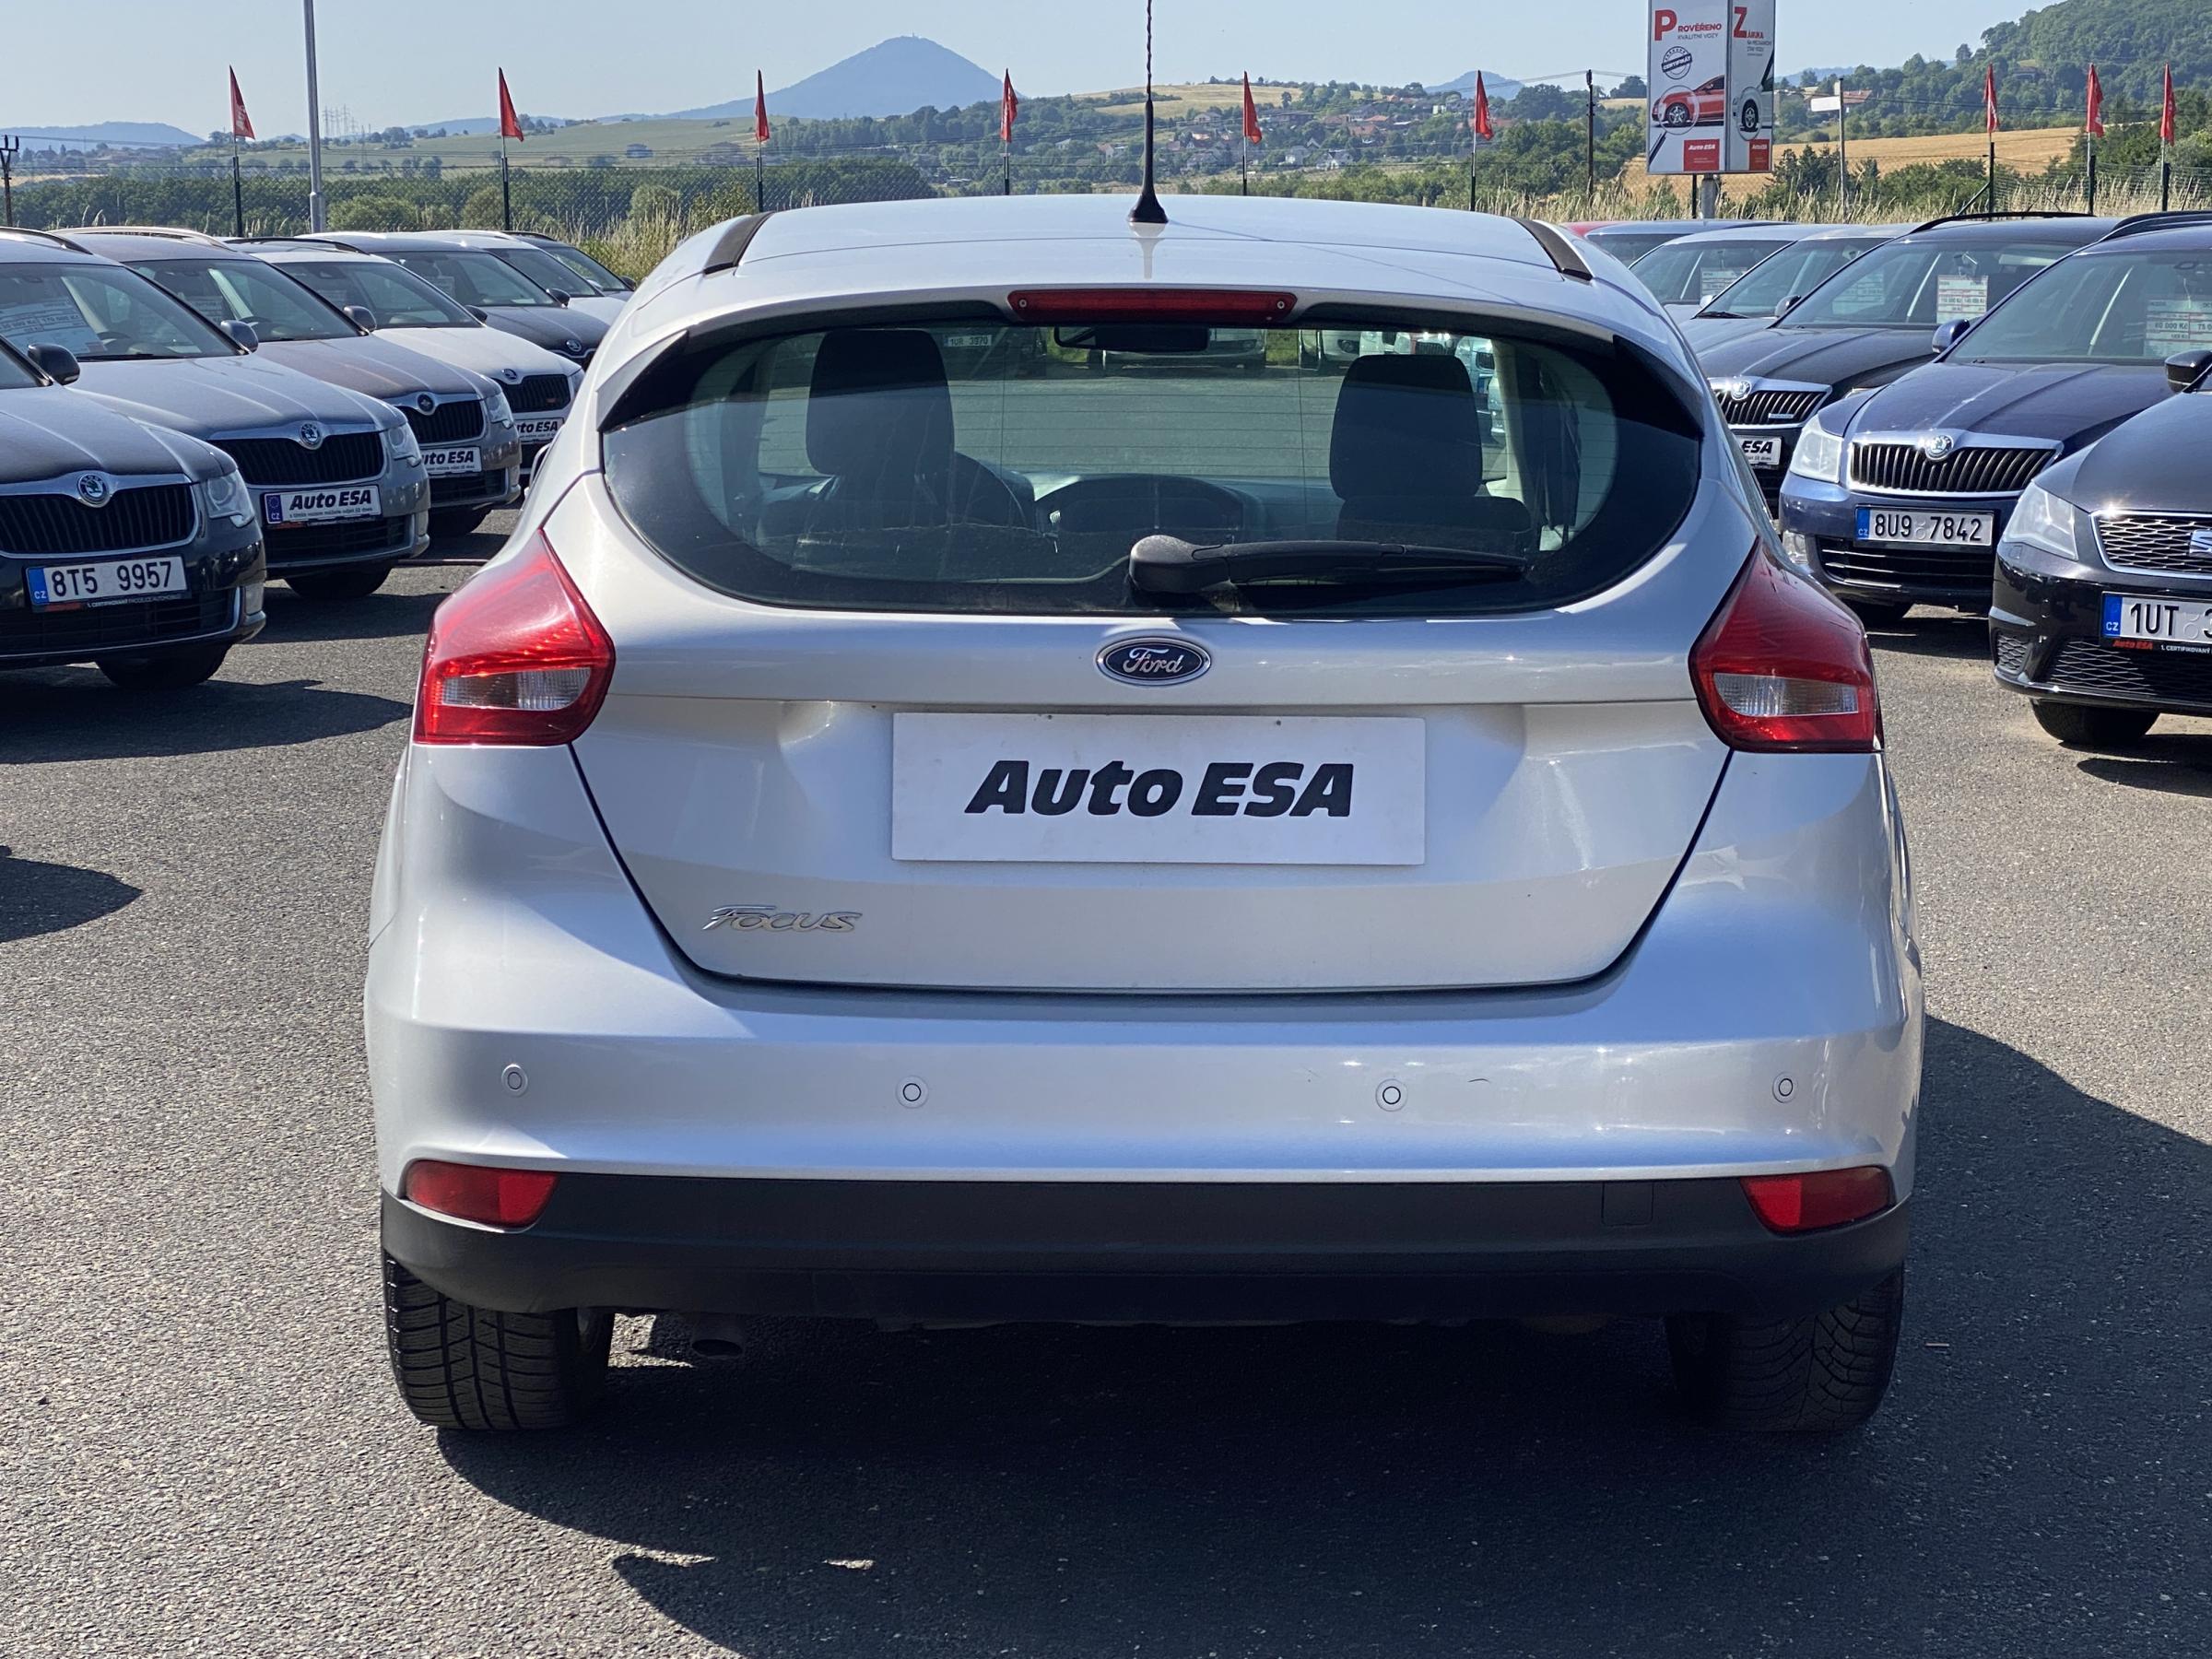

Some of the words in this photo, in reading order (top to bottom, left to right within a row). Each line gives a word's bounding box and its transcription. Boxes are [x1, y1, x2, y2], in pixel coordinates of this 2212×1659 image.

[535, 421, 558, 432] ESA
[1742, 441, 1773, 453] ESA
[421, 453, 446, 465] uto
[447, 451, 474, 464] ESA
[289, 493, 336, 511] Auto
[338, 490, 371, 507] ESA
[1875, 513, 1912, 538] 8U9
[1930, 516, 1982, 541] 7842
[52, 568, 98, 597] 8T5
[116, 560, 171, 591] 9957
[34, 591, 46, 599] CZ
[2105, 621, 2119, 631] CZ
[2130, 603, 2179, 636] 1UT
[1123, 647, 1184, 673] Ford
[964, 760, 1183, 817] Auto
[1191, 761, 1354, 818] ESA
